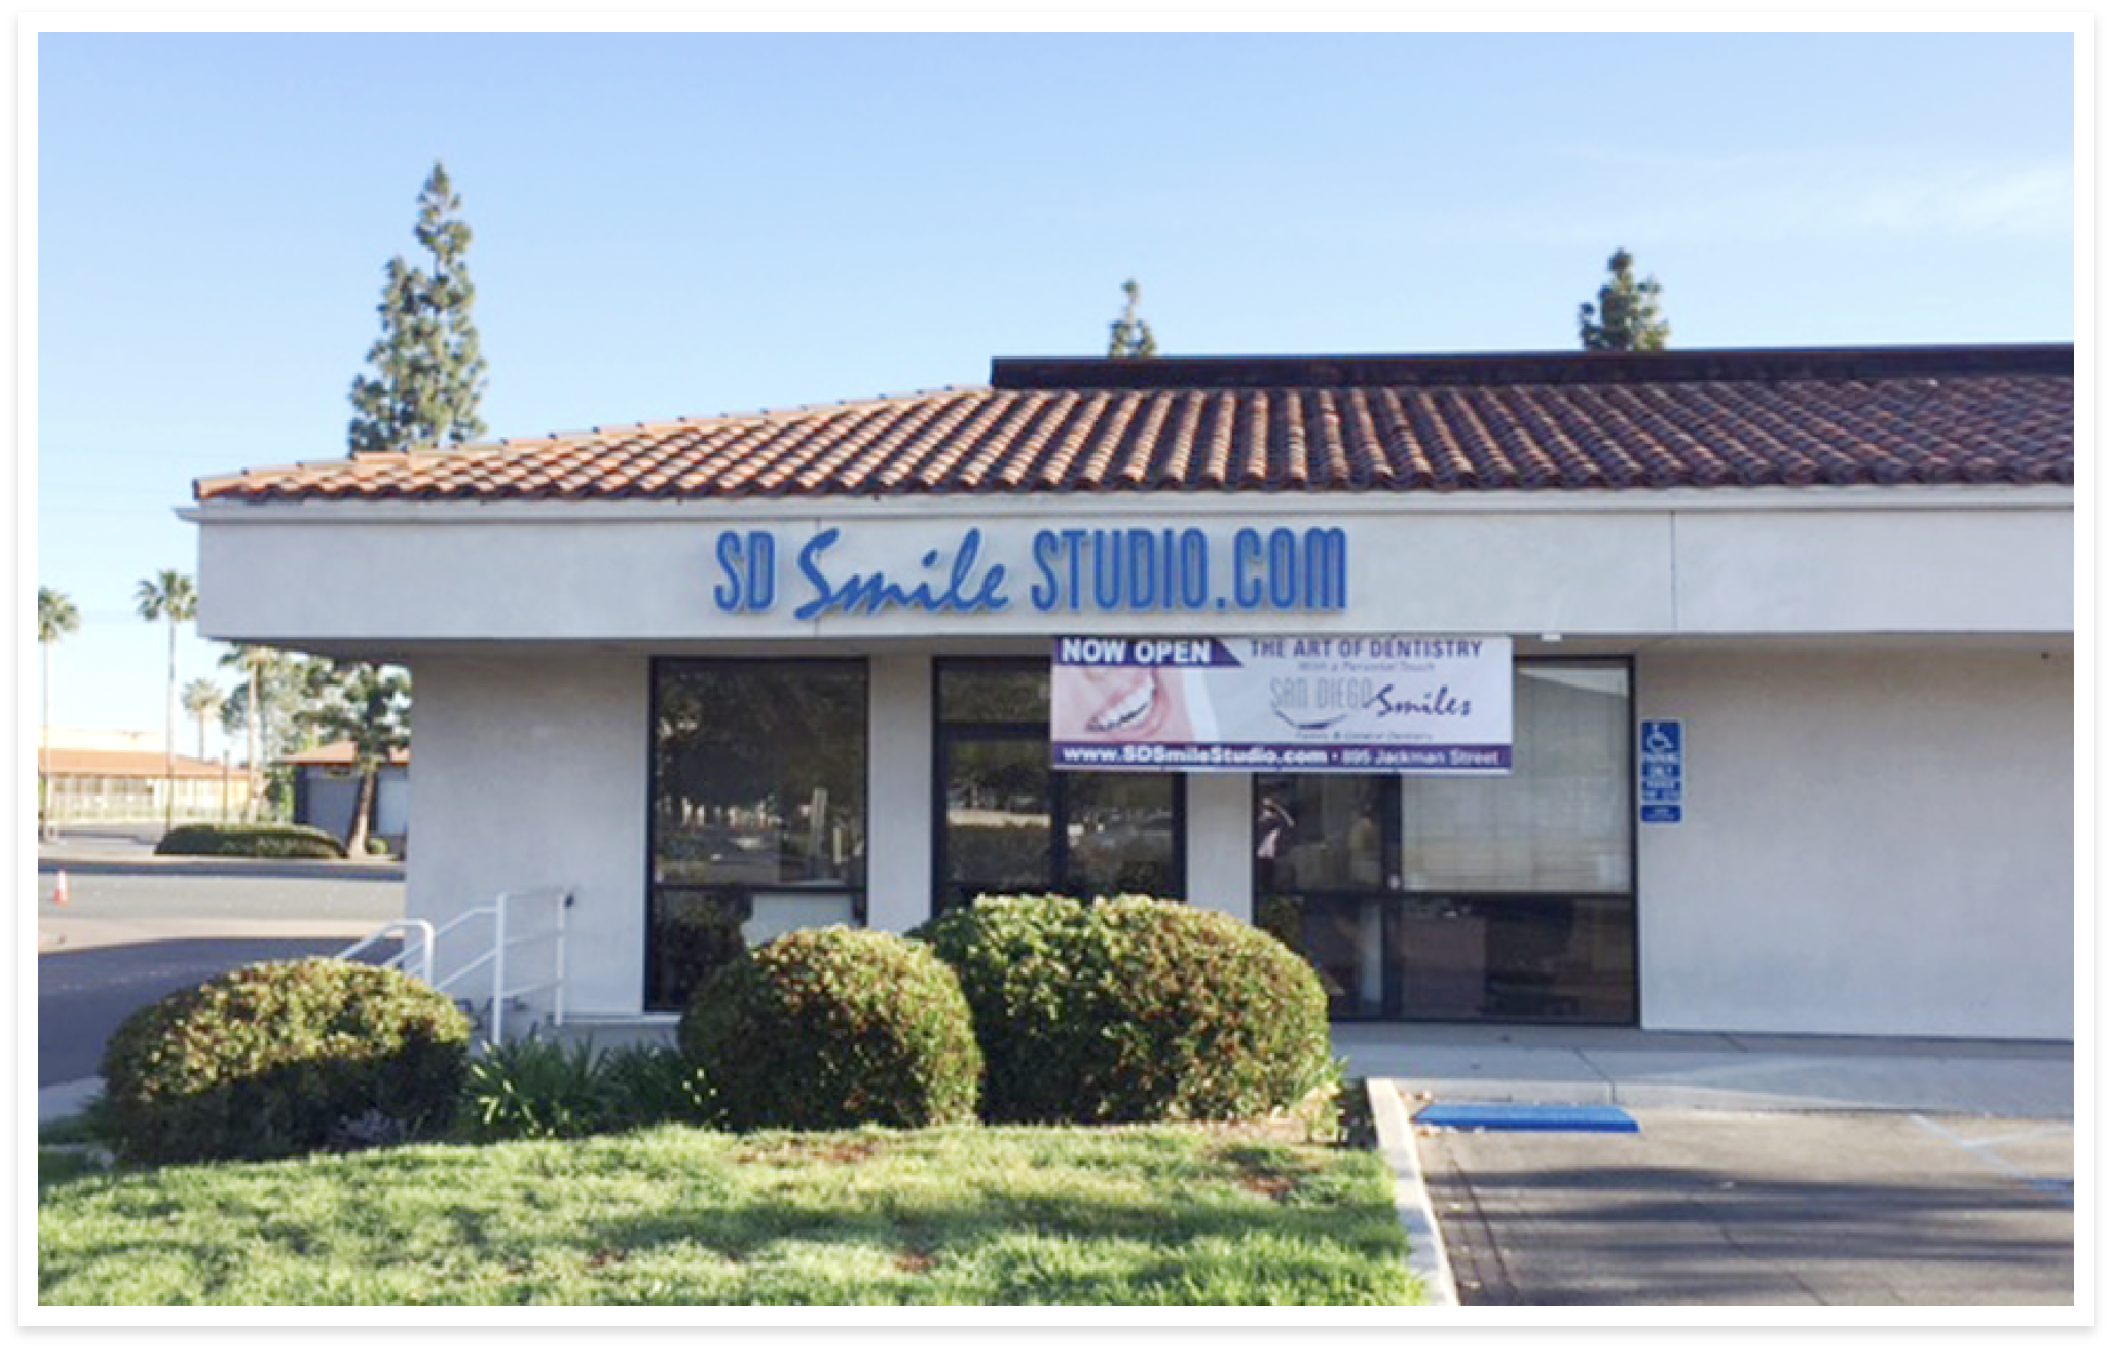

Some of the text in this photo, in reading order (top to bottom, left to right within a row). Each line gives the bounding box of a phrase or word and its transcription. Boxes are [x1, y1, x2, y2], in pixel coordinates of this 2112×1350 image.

[714, 526, 1347, 620] SD Smile STUDIO.COM
[1063, 638, 1211, 662] NOW OPEN
[1251, 640, 1483, 658] THE ART OF DENTISTRY
[1269, 676, 1472, 717] SAN DIEGO Smiles
[1063, 744, 1328, 763] www.SDSmileStudio.com
[1374, 748, 1445, 765] Jackman
[1448, 748, 1500, 765] Street
